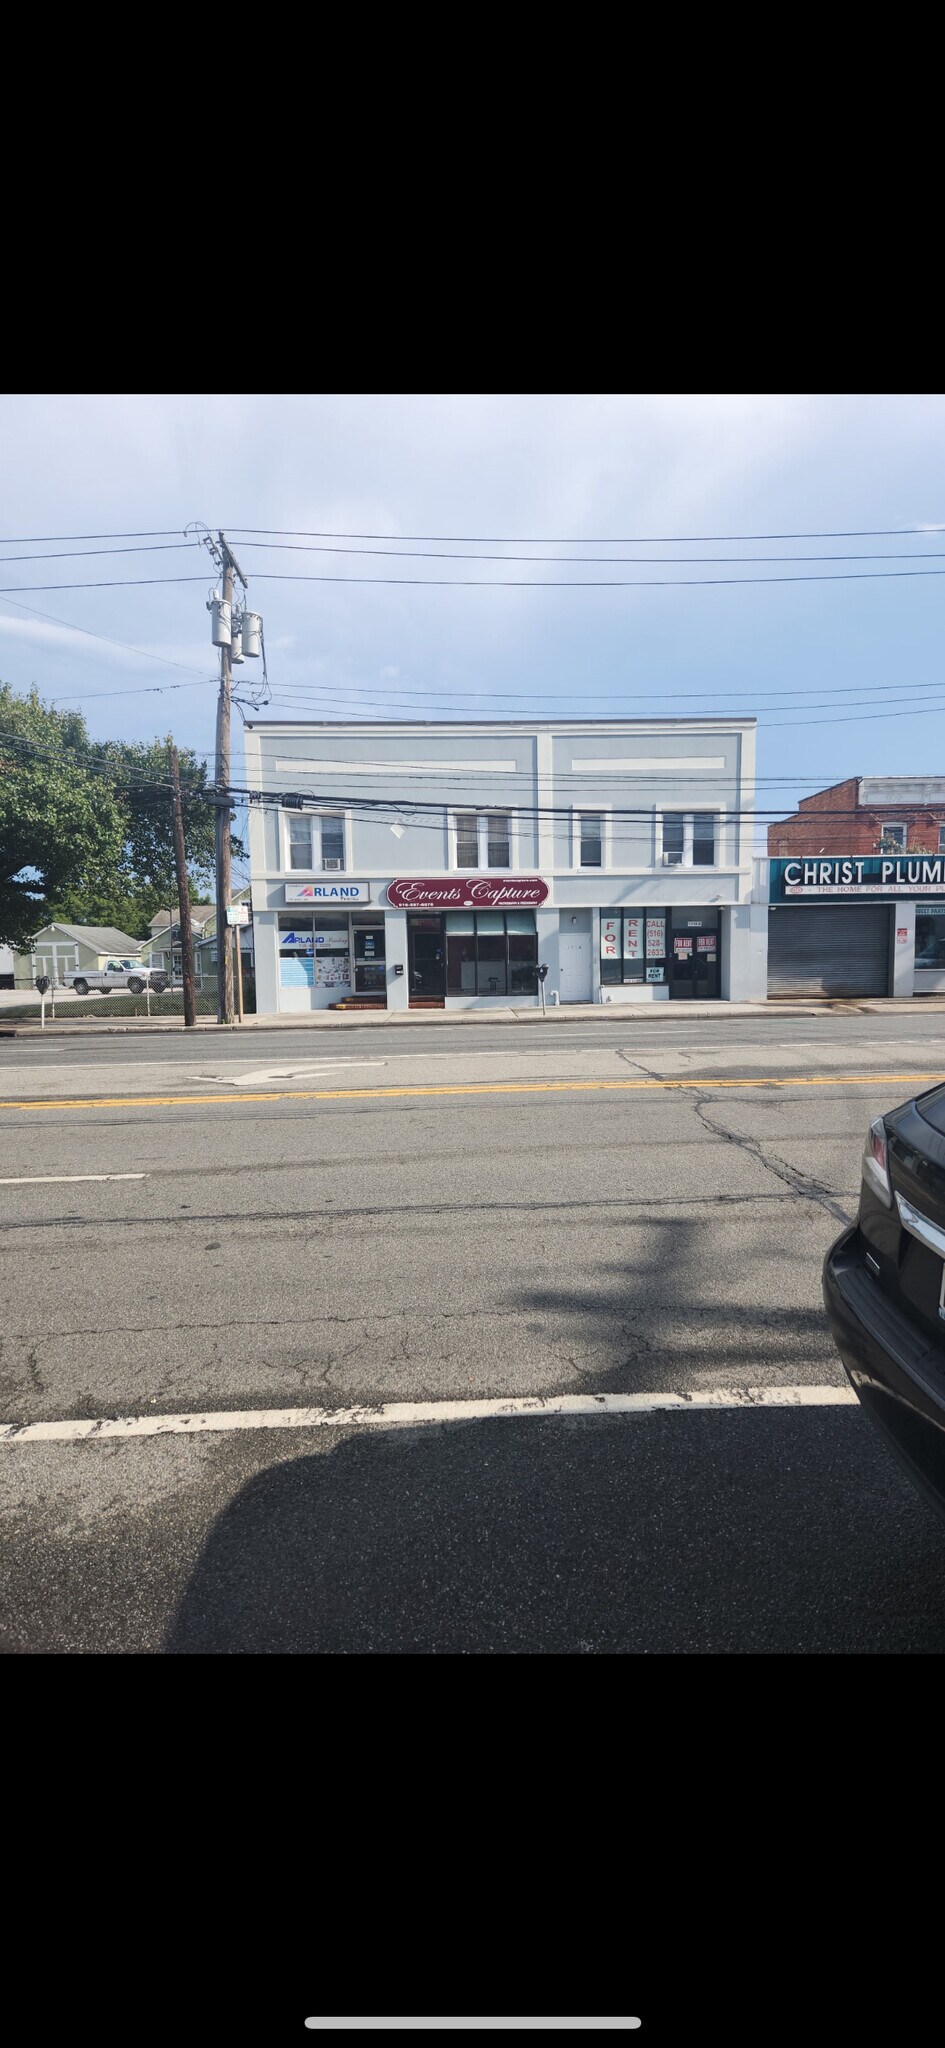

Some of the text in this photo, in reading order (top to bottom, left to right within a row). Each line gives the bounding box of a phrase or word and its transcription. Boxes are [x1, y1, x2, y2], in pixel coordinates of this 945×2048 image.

[784, 862, 865, 885] CHRIST
[396, 880, 540, 905] Events Capture
[647, 920, 665, 928] CALL
[647, 930, 663, 938] (516)
[604, 921, 616, 954] FOR
[628, 919, 639, 957] RENT
